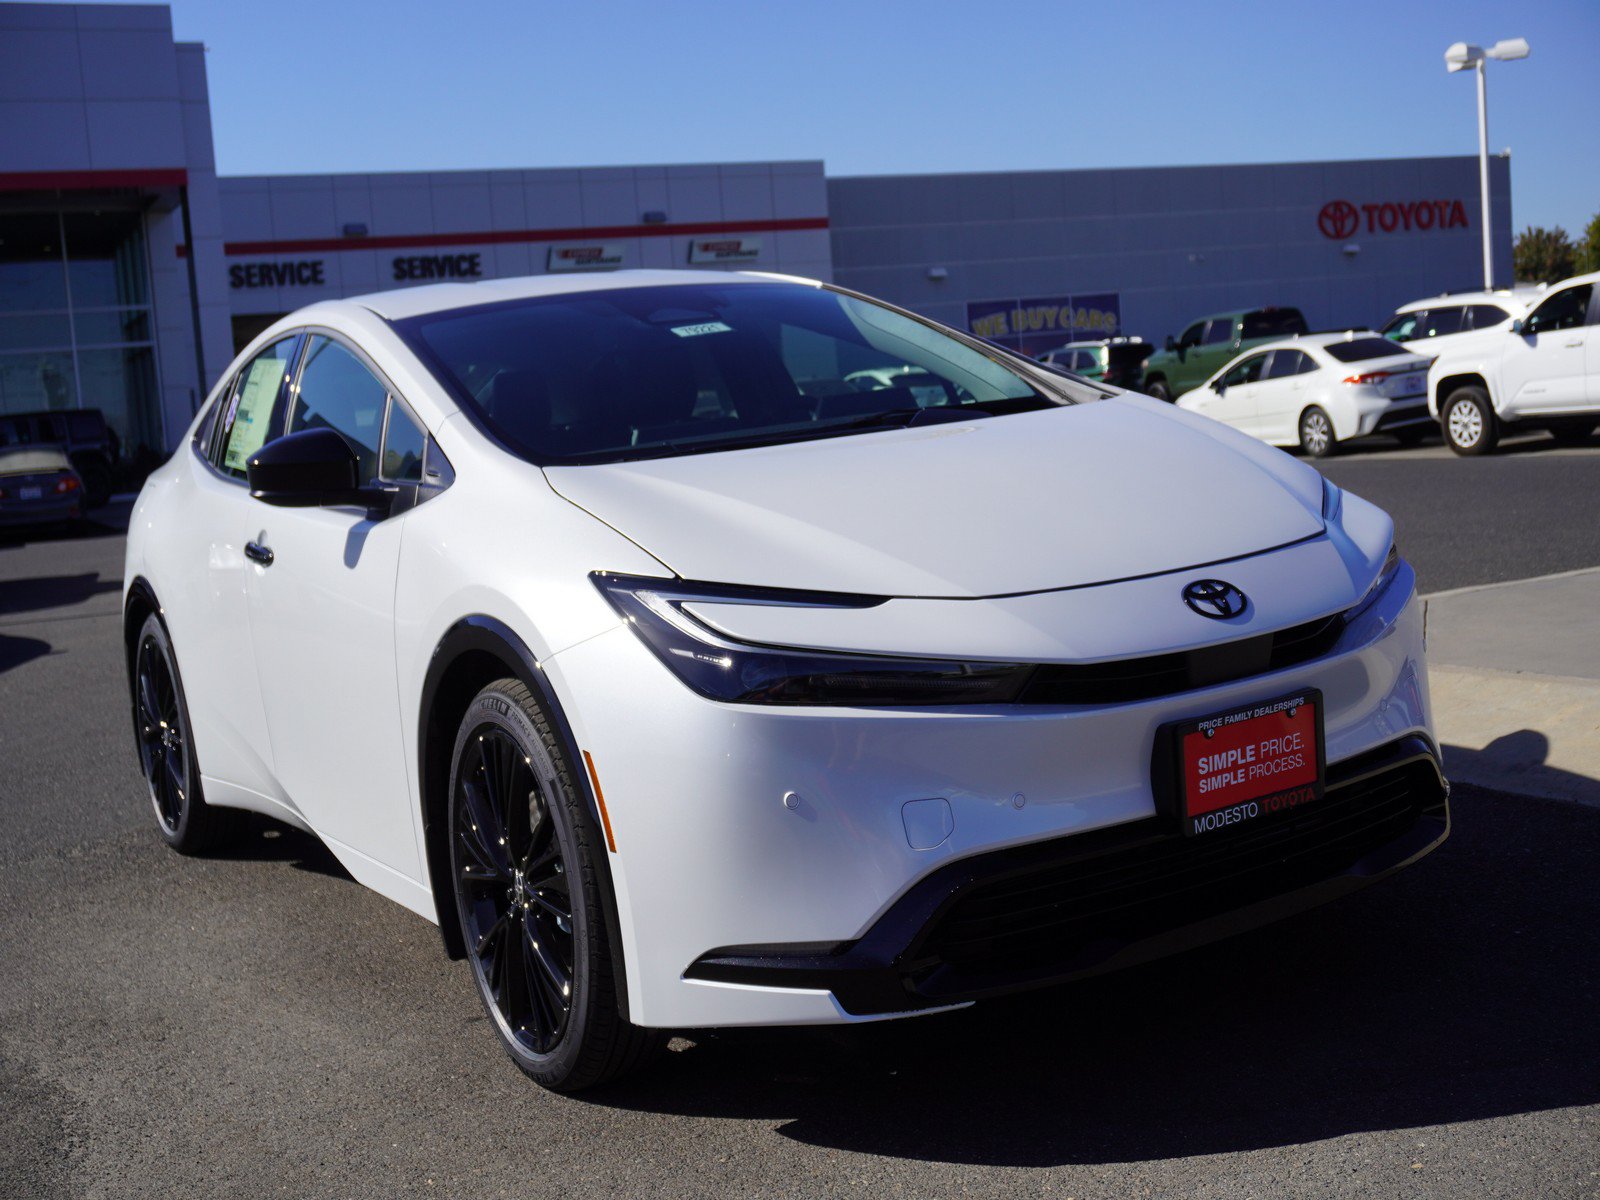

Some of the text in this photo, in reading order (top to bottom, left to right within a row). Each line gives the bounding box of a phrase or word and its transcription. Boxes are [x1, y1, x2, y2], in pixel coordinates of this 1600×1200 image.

[1361, 200, 1469, 233] TOYOTA
[228, 260, 324, 289] SERVICE
[392, 253, 481, 281] SERVICE
[972, 306, 1117, 338] WE BUY CARS
[1198, 697, 1304, 731] PRICE FAMILY DEALERSHIPS
[1198, 732, 1305, 775] SIMPLE PRICE.
[1199, 753, 1306, 794] SIMPLE PROCESS.
[1194, 788, 1316, 834] MODESTO TOYOTA
